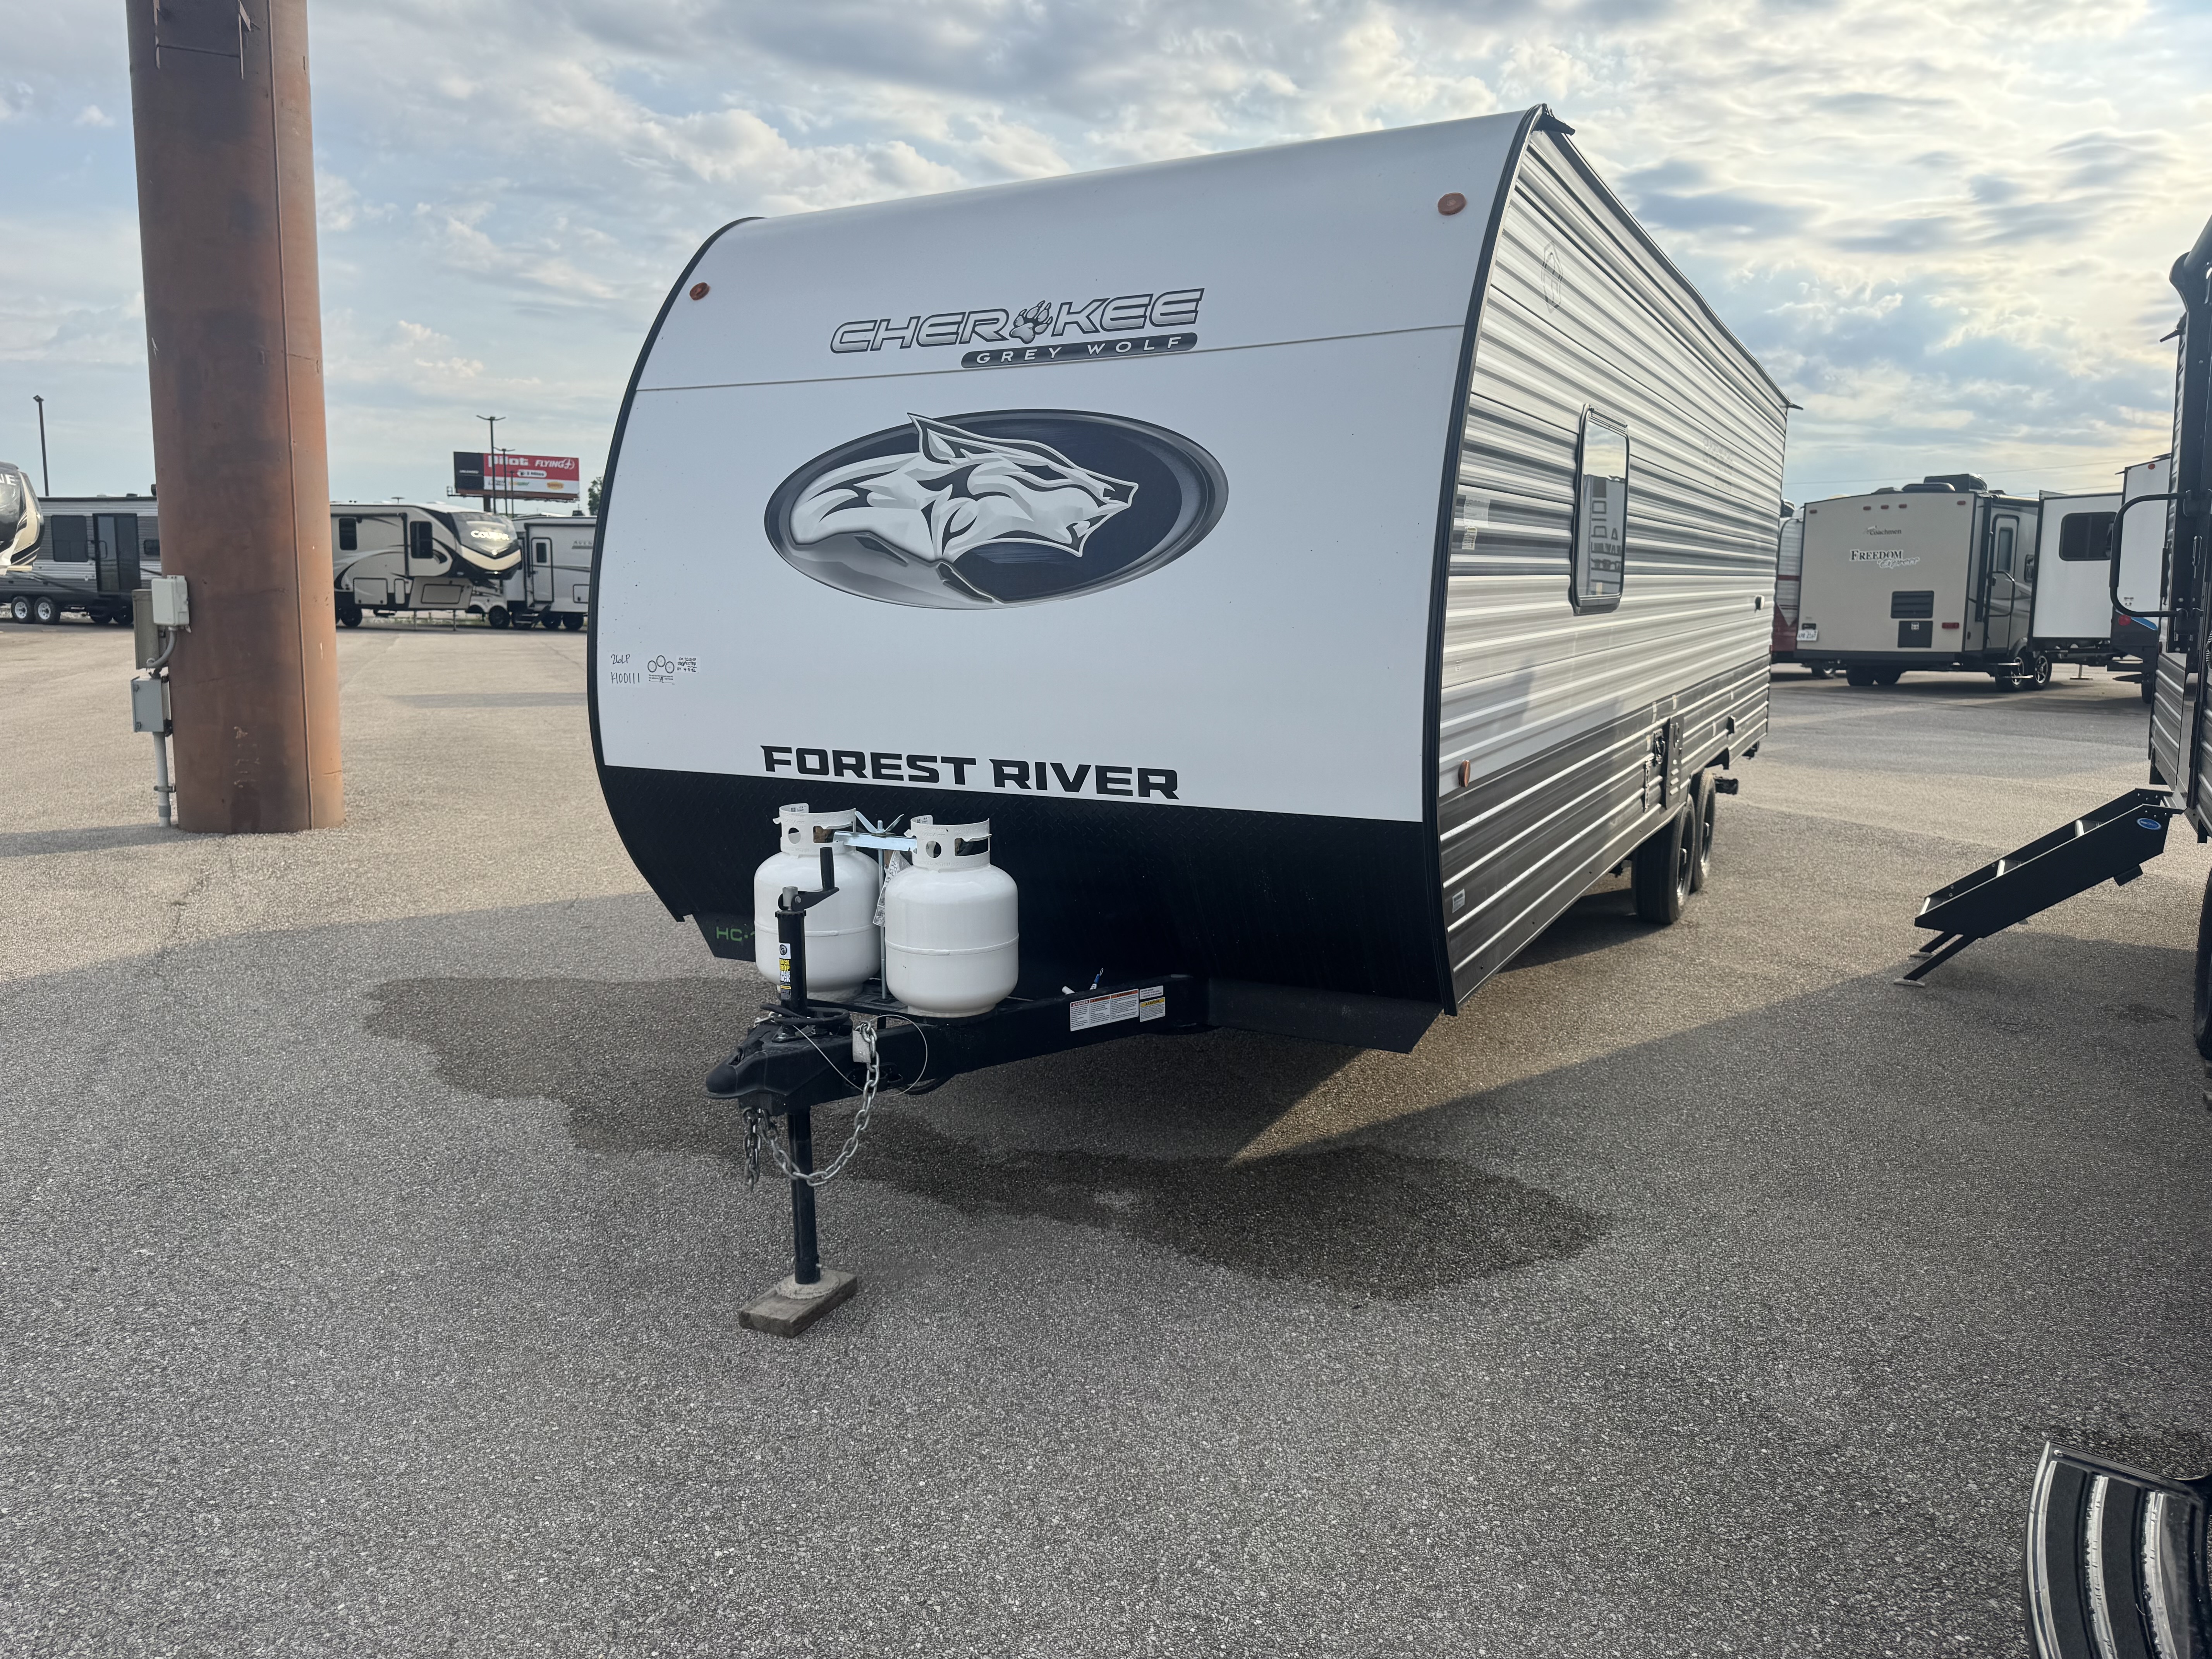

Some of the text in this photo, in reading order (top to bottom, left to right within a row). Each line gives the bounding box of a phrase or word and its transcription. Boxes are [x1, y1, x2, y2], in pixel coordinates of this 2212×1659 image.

[976, 336, 1182, 365] GREY WOLF
[1851, 550, 1903, 560] FREEDOM
[760, 745, 1180, 800] FOREST RIVER
